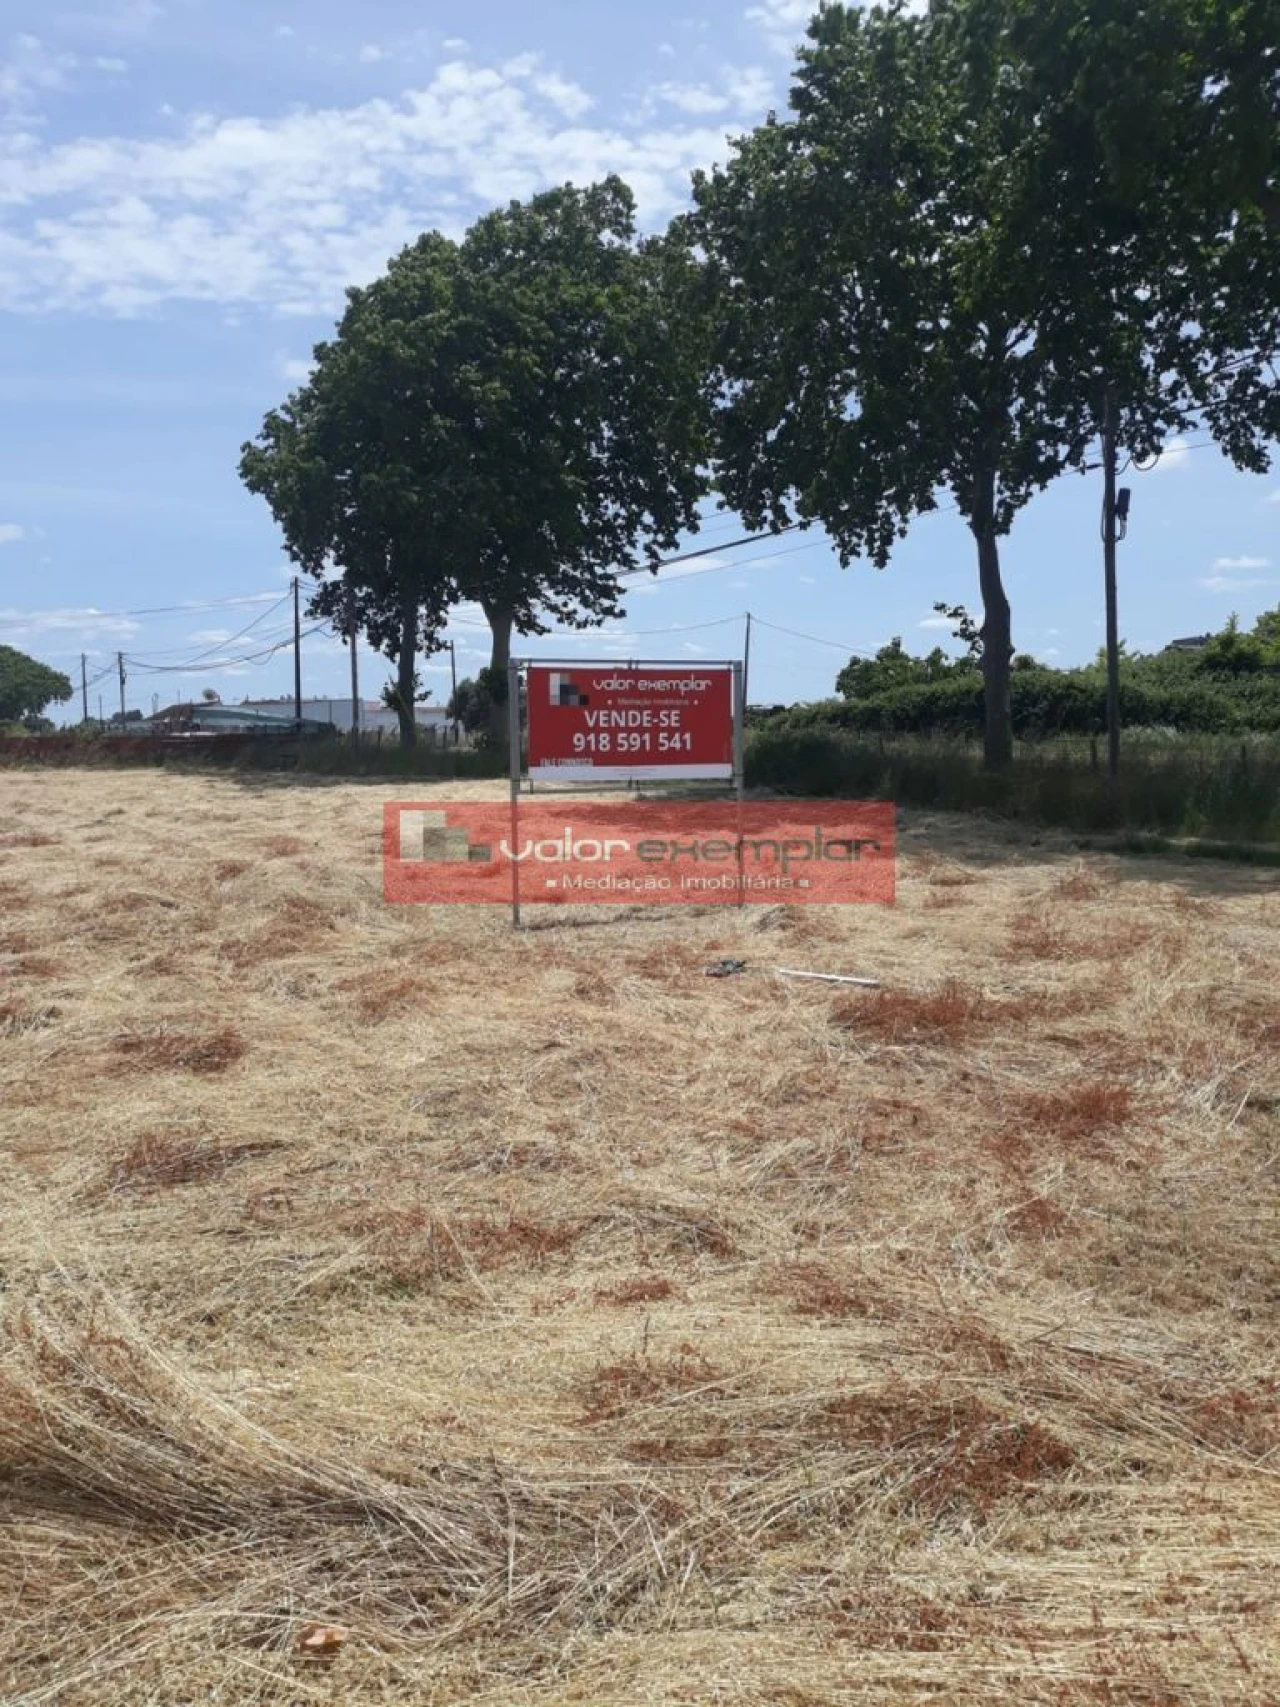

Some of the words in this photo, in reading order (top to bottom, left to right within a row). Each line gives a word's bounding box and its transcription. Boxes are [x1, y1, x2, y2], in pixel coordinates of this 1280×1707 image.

[592, 673, 636, 691] valor
[638, 673, 713, 697] exemplar
[585, 711, 681, 727] VENDE-SE
[573, 733, 611, 751] 918
[617, 733, 651, 751] 591
[659, 733, 692, 751] 541
